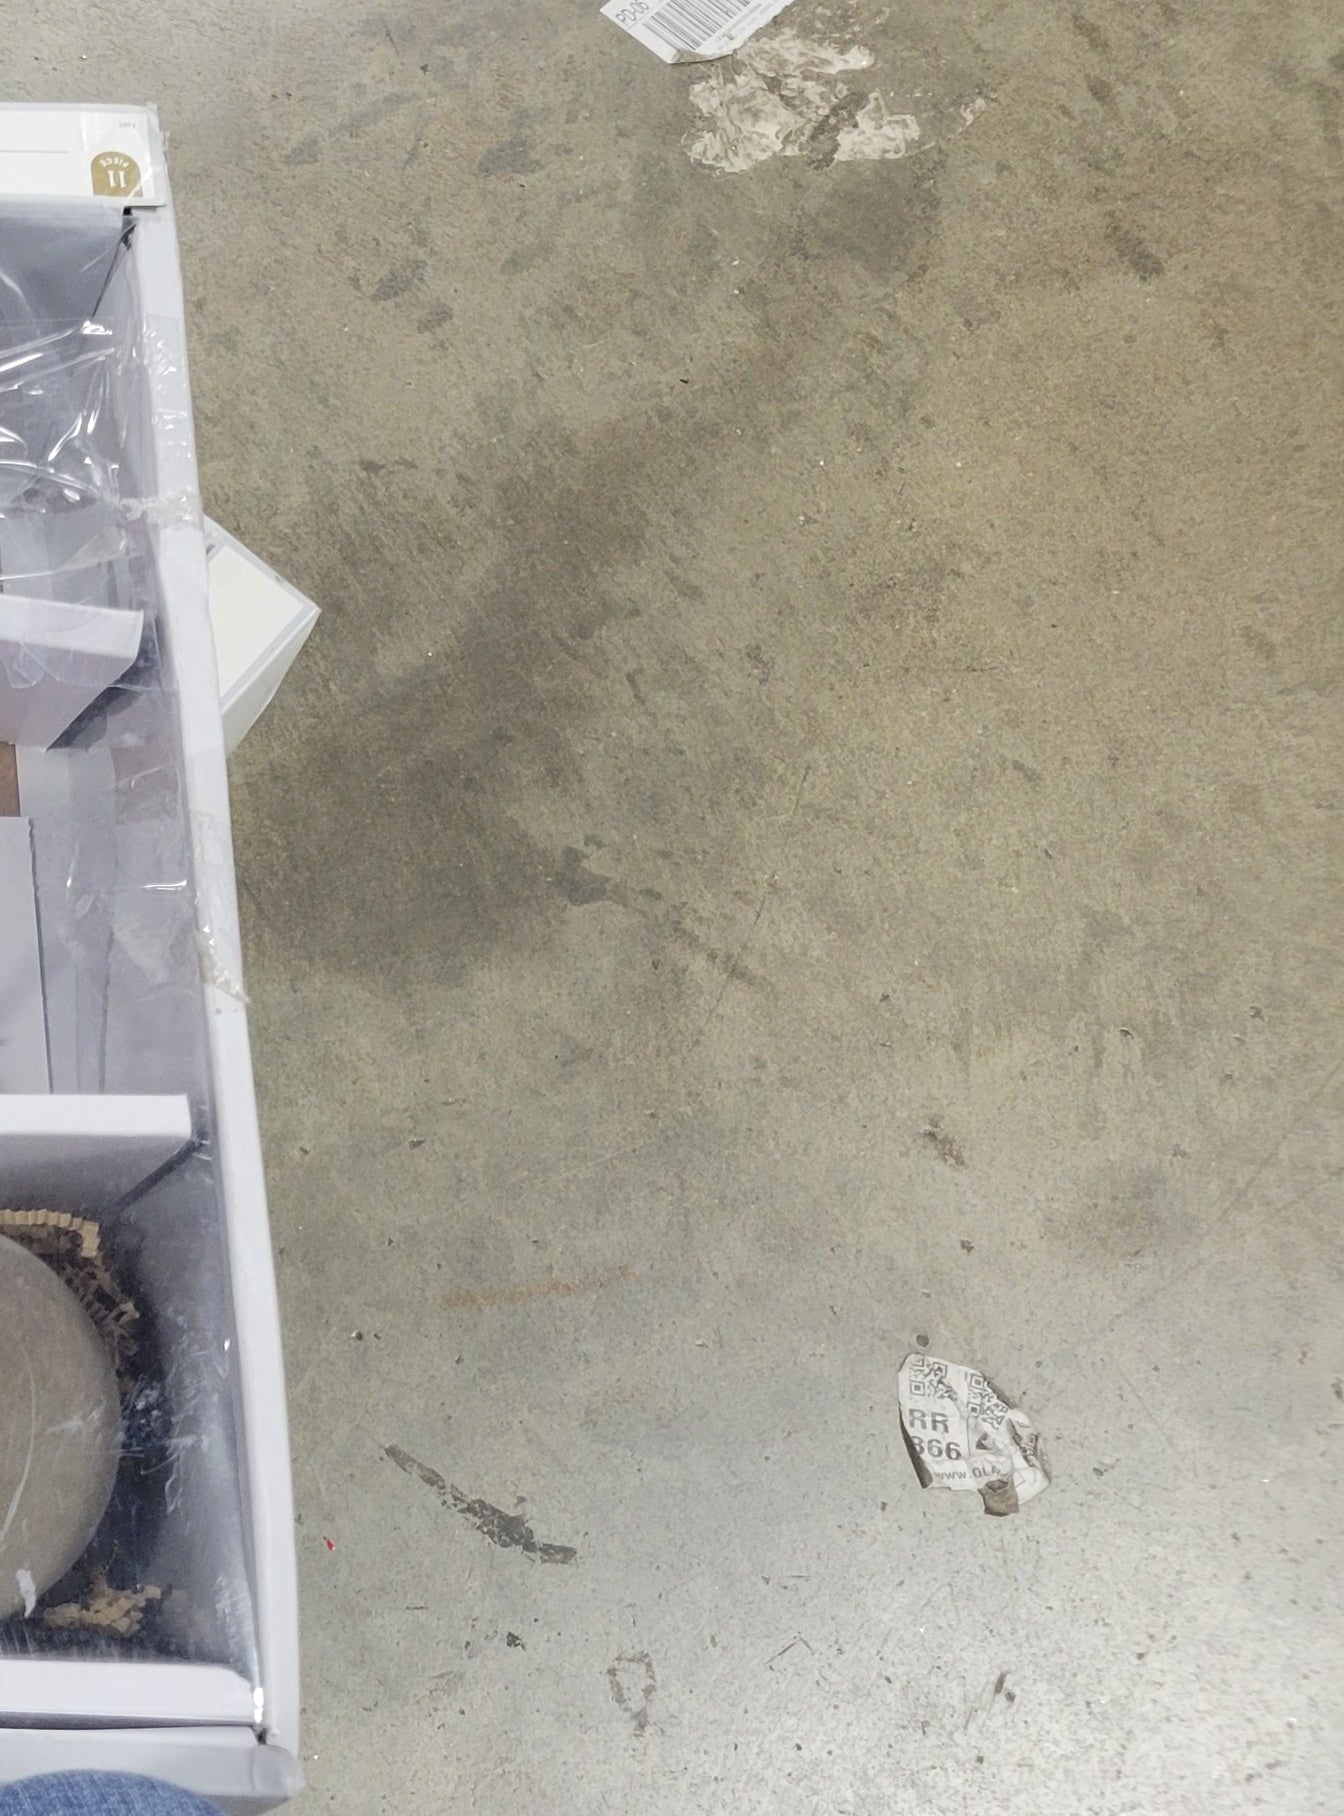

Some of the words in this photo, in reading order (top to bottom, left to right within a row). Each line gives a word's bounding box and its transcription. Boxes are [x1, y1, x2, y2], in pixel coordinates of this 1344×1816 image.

[98, 157, 129, 168] PIECE
[106, 169, 126, 188] 11
[908, 1408, 950, 1434] RR
